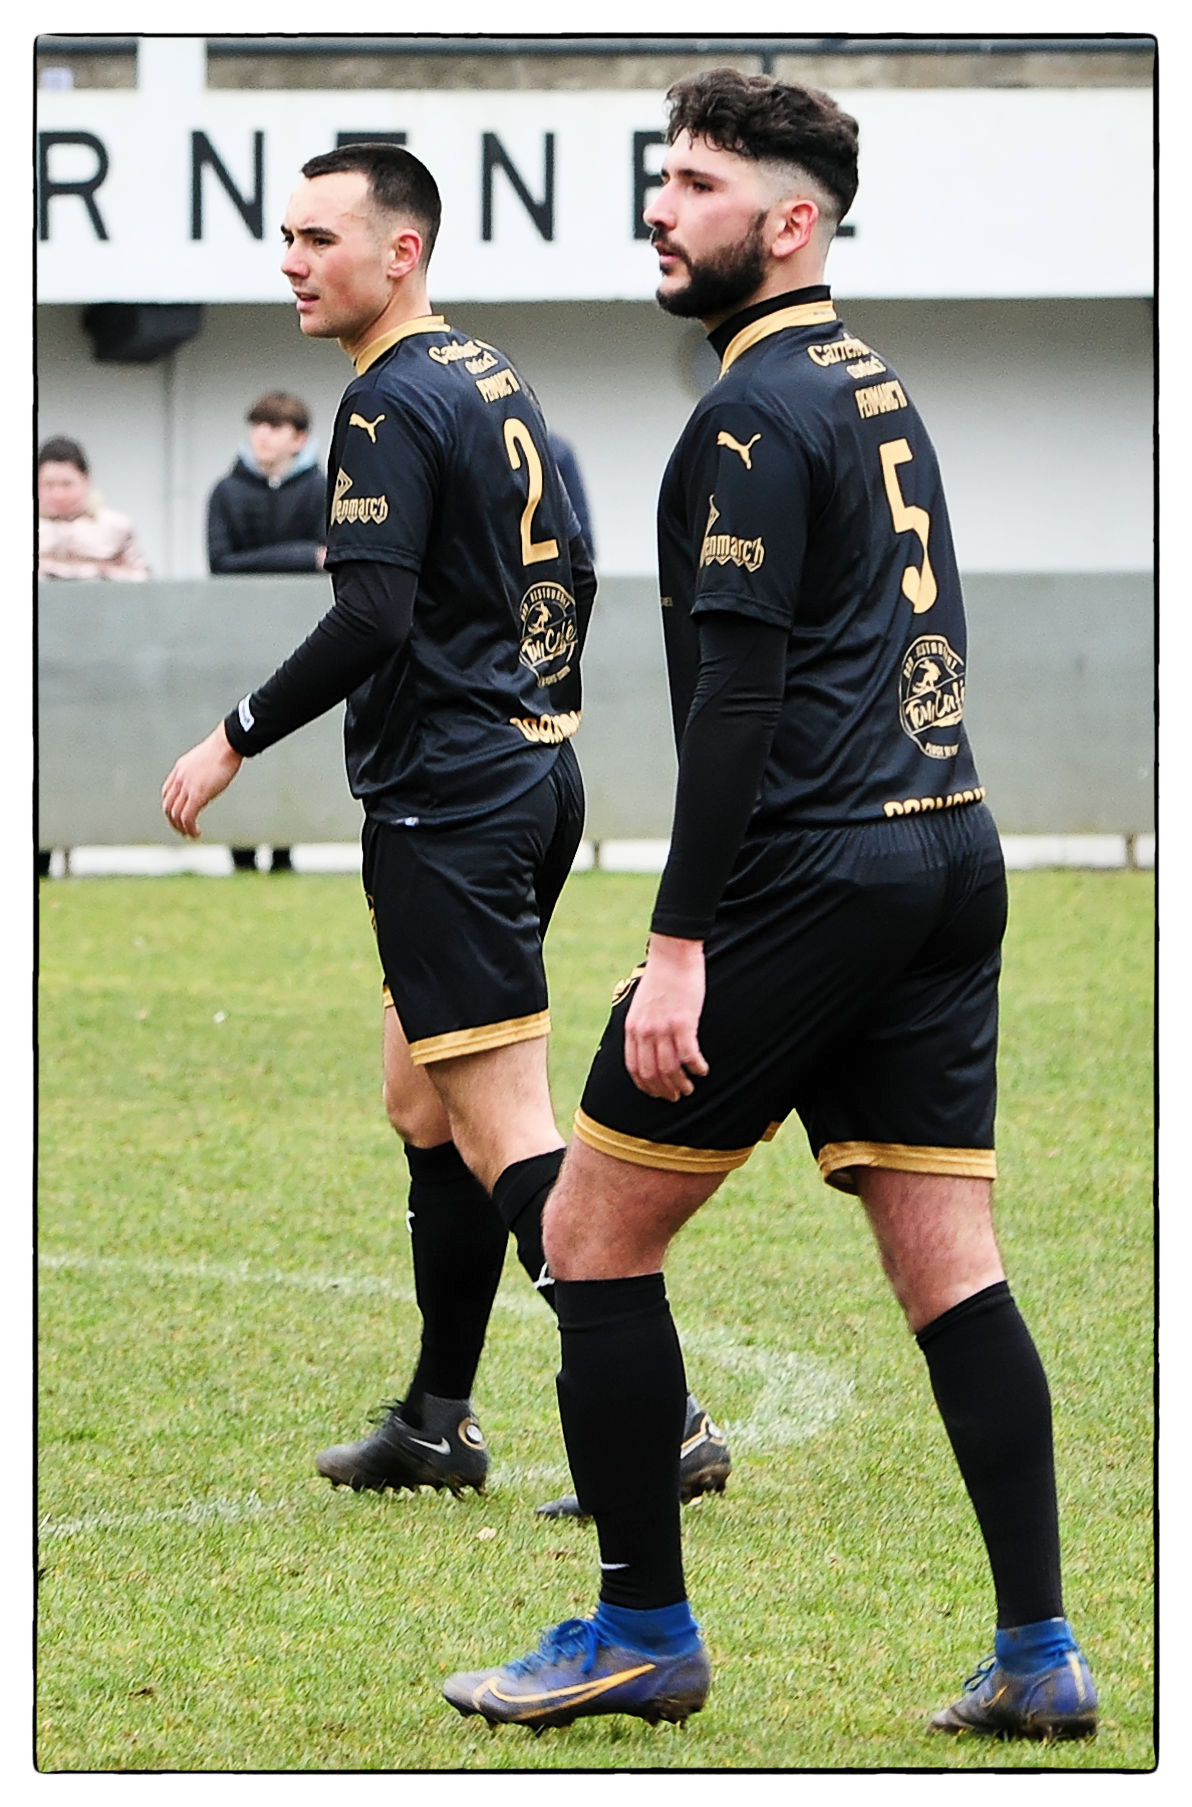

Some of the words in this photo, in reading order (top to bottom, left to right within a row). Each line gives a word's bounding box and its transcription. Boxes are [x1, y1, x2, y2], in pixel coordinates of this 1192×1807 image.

[38, 131, 855, 241] RNNE
[504, 418, 559, 566] 2
[879, 438, 937, 614] 5
